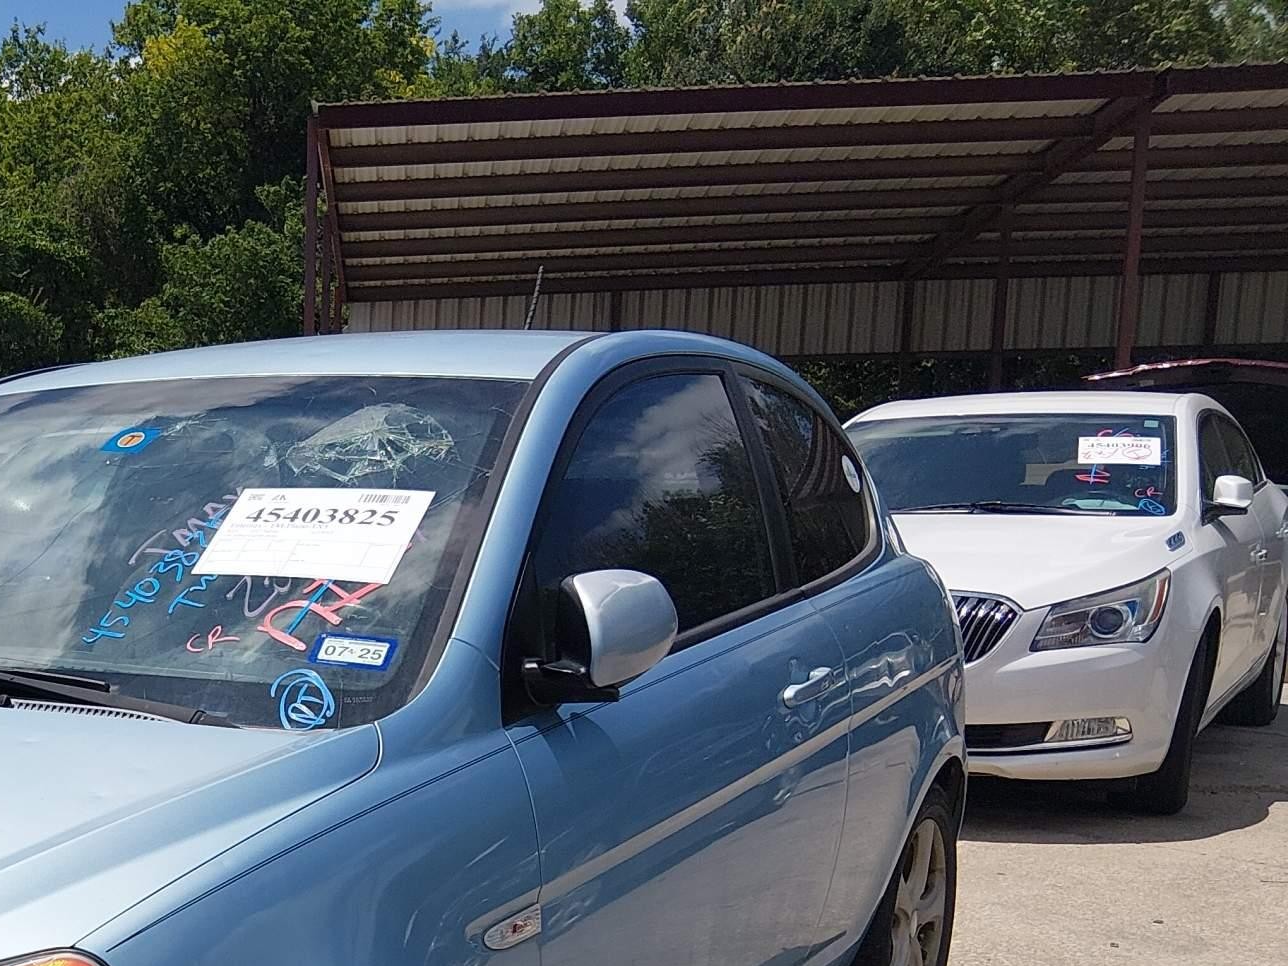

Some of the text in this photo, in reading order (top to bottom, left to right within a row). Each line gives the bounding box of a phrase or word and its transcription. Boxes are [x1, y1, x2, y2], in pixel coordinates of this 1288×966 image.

[245, 507, 401, 527] 45403825
[324, 645, 384, 661] 07 25
